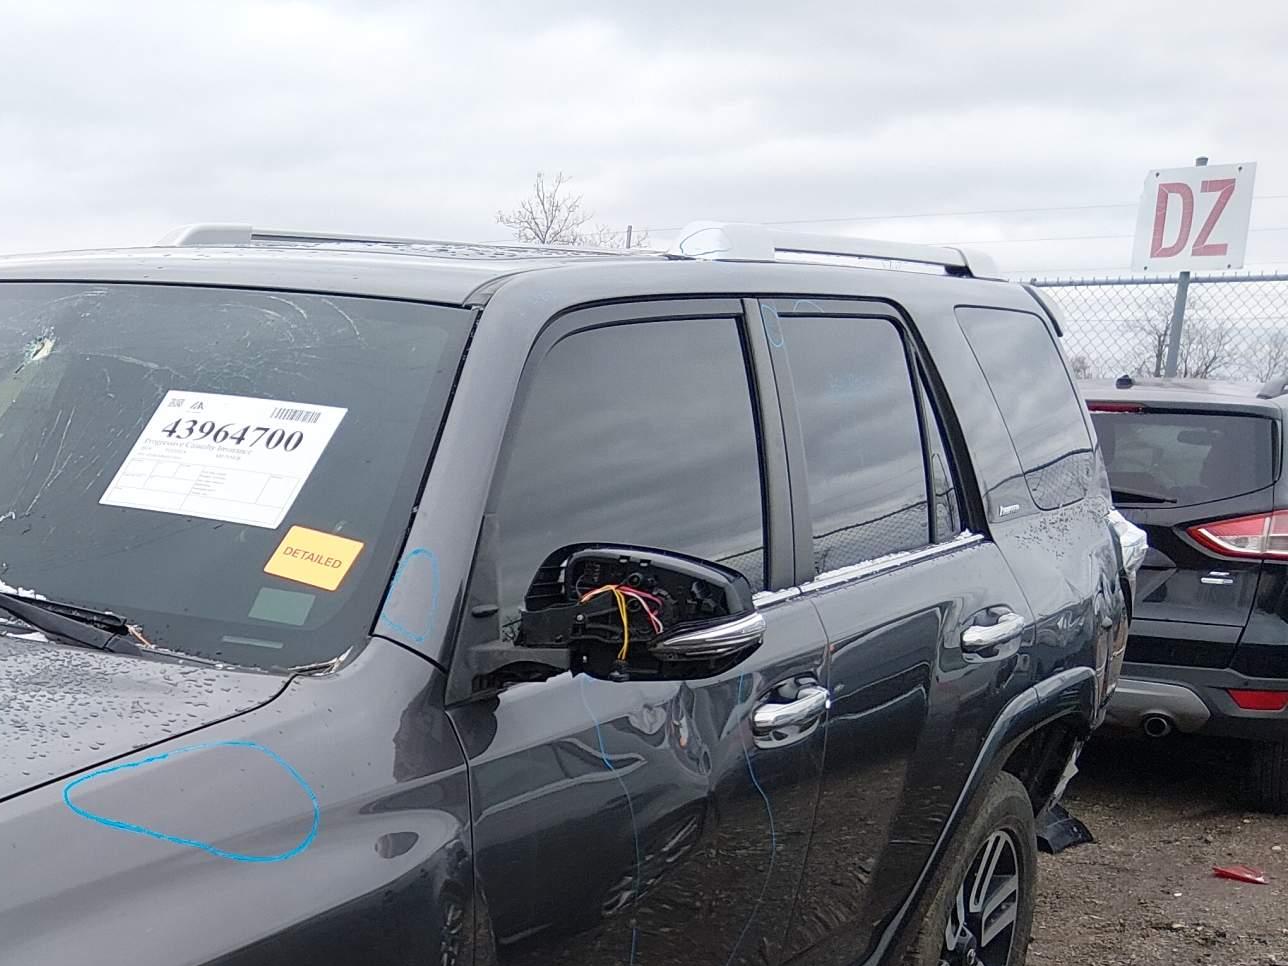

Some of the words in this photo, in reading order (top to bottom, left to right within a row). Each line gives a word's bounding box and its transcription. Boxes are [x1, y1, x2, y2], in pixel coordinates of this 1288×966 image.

[1150, 178, 1236, 258] DZ
[162, 417, 304, 452] 43964700
[283, 546, 342, 569] DETAILED
